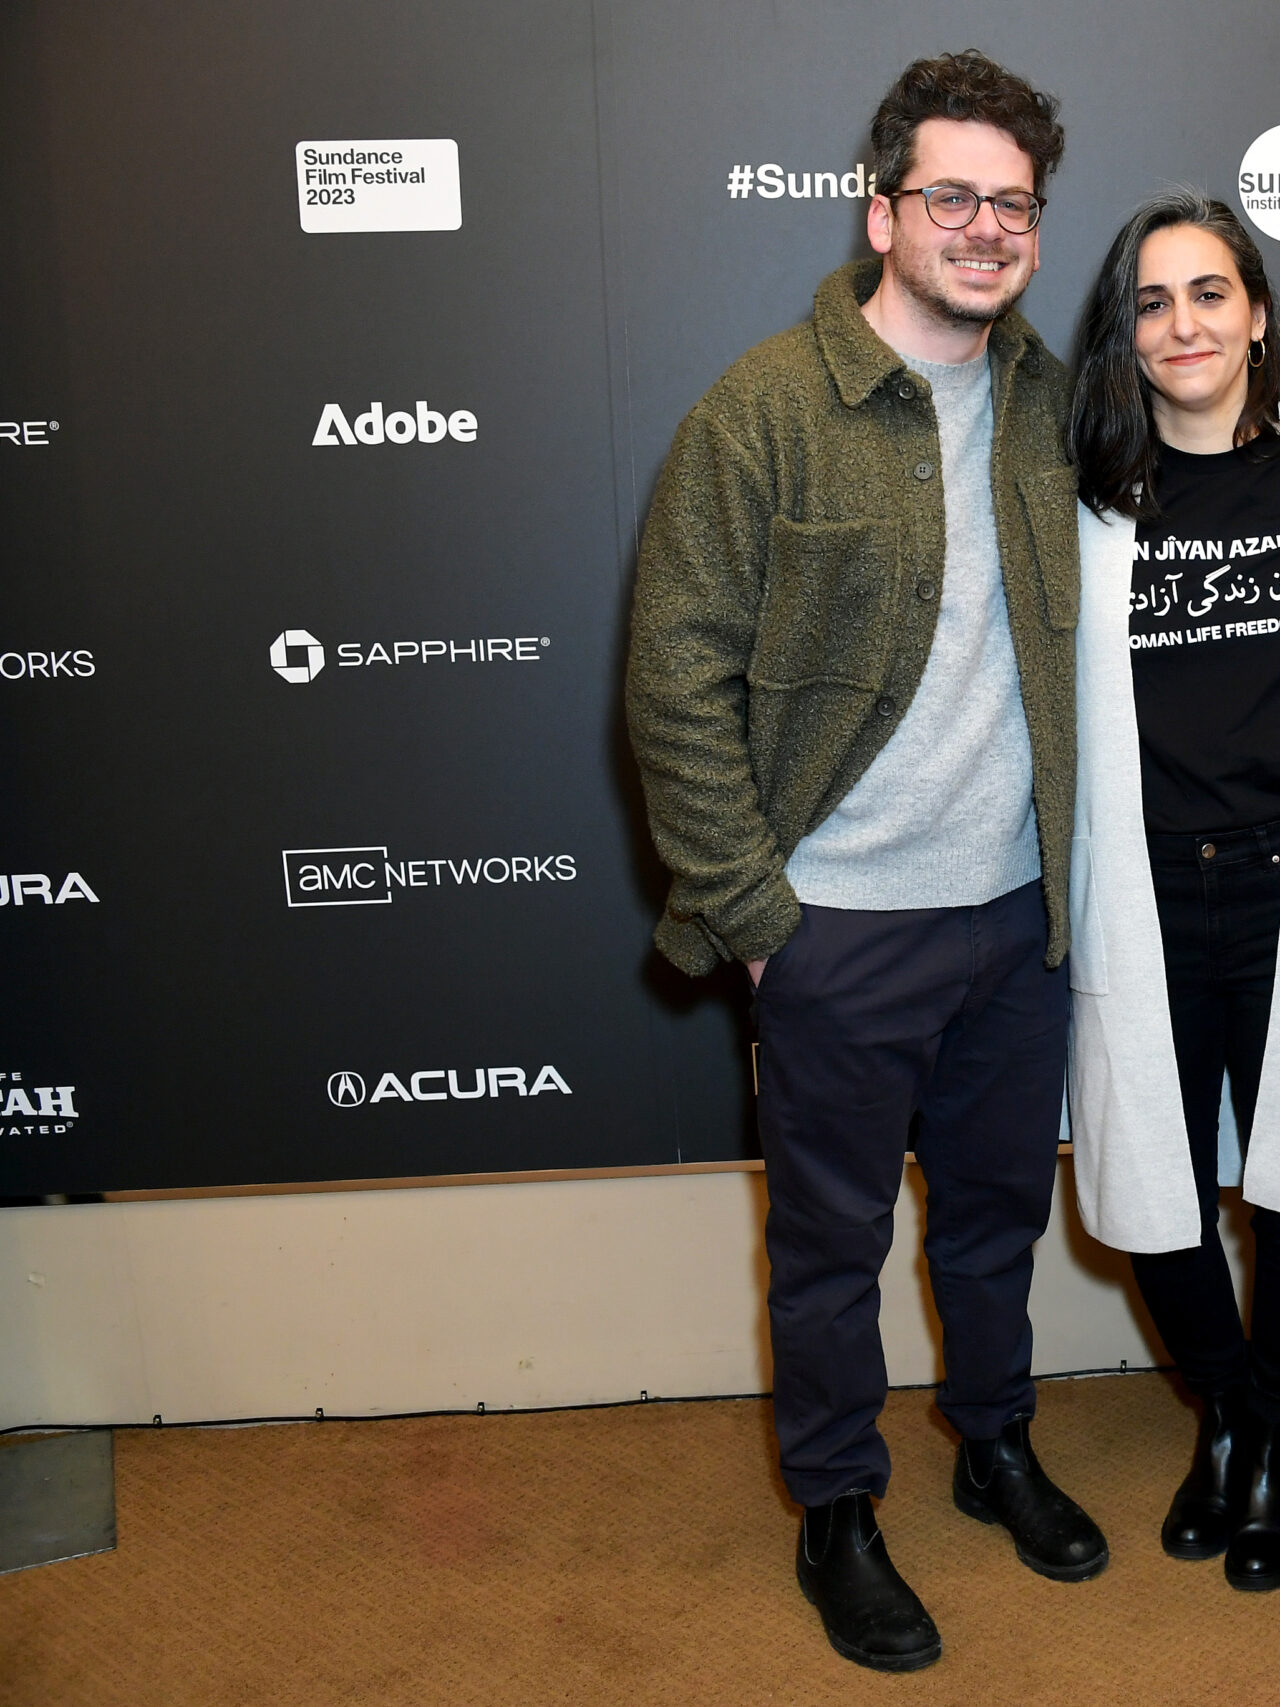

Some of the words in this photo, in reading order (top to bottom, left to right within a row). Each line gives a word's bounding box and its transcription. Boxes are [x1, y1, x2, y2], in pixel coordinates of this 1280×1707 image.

[303, 148, 403, 166] Sundance
[305, 168, 347, 186] Film
[351, 167, 426, 185] Festival
[306, 188, 356, 206] 2023
[311, 400, 478, 446] Adobe
[1155, 535, 1224, 561] JÎYAN
[1186, 625, 1223, 644] LIFE
[384, 854, 577, 888] NETWORKS
[369, 1065, 573, 1103] ACURA
